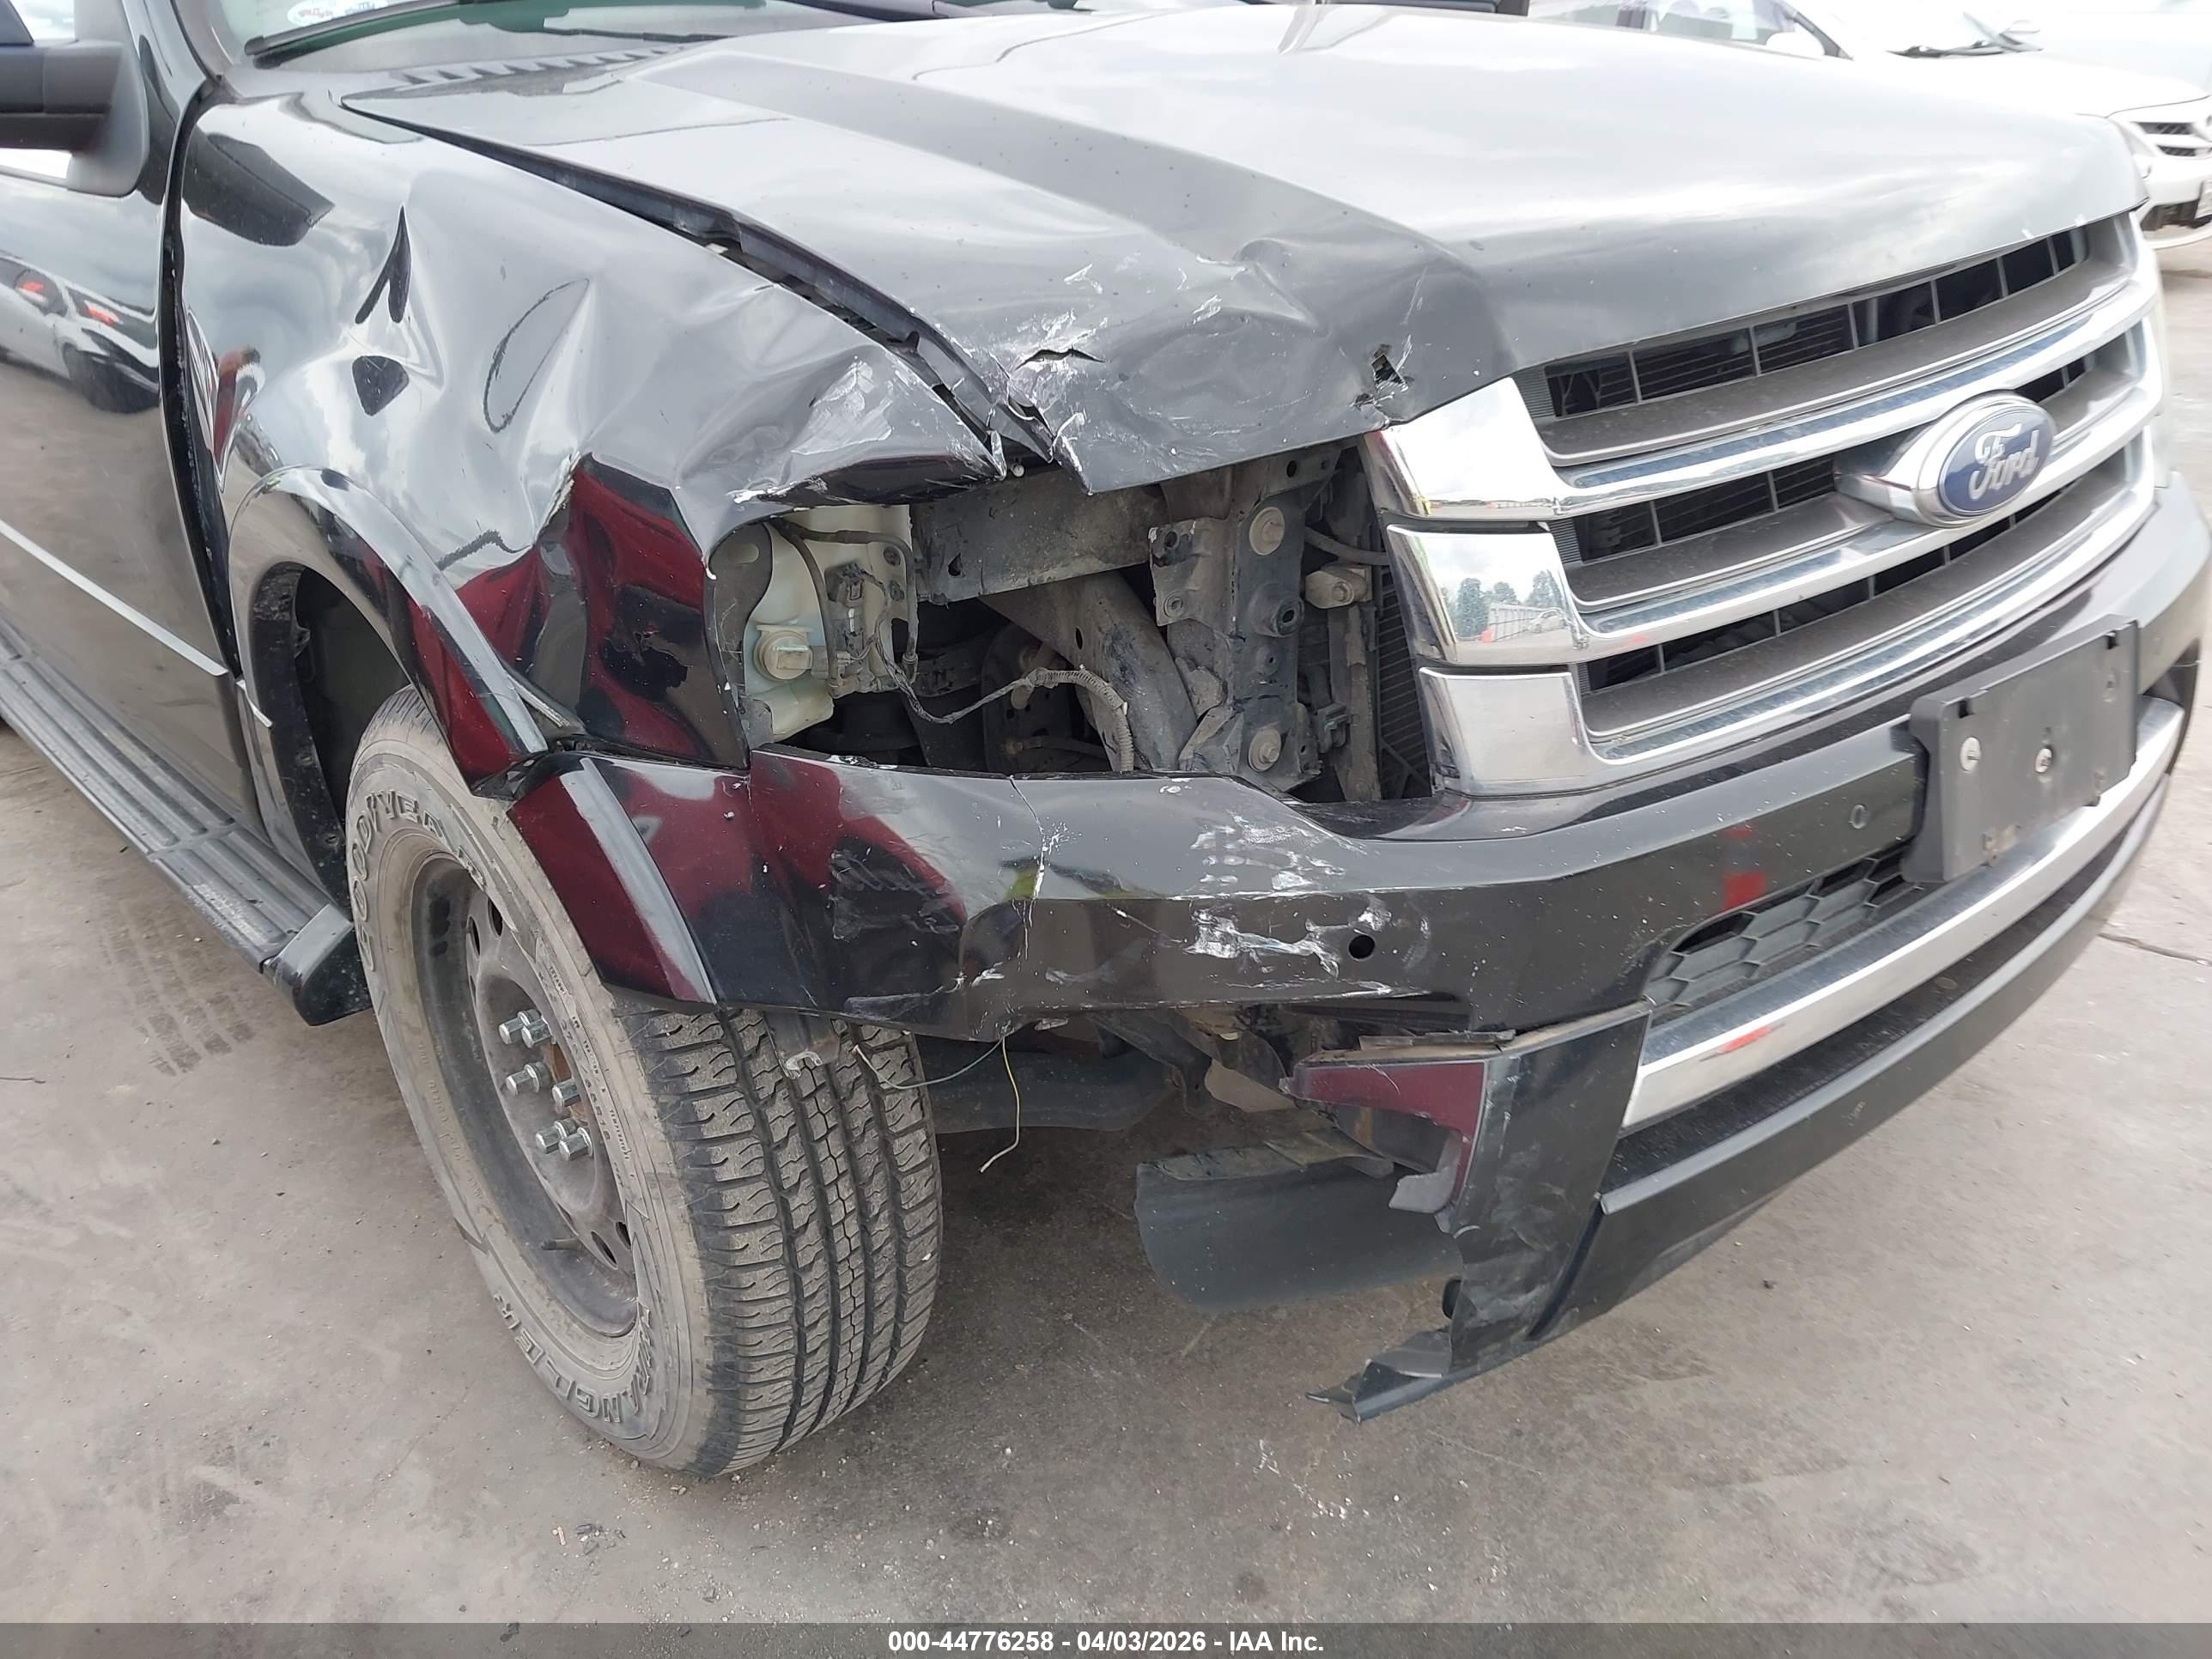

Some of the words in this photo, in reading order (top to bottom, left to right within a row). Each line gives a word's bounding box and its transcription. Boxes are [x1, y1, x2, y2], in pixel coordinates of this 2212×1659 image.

[1968, 423, 2039, 501] Ford
[351, 787, 487, 973] GOODYEAR
[610, 1109, 629, 1159] TEMPERATURE
[492, 1293, 652, 1424] WRANGLER
